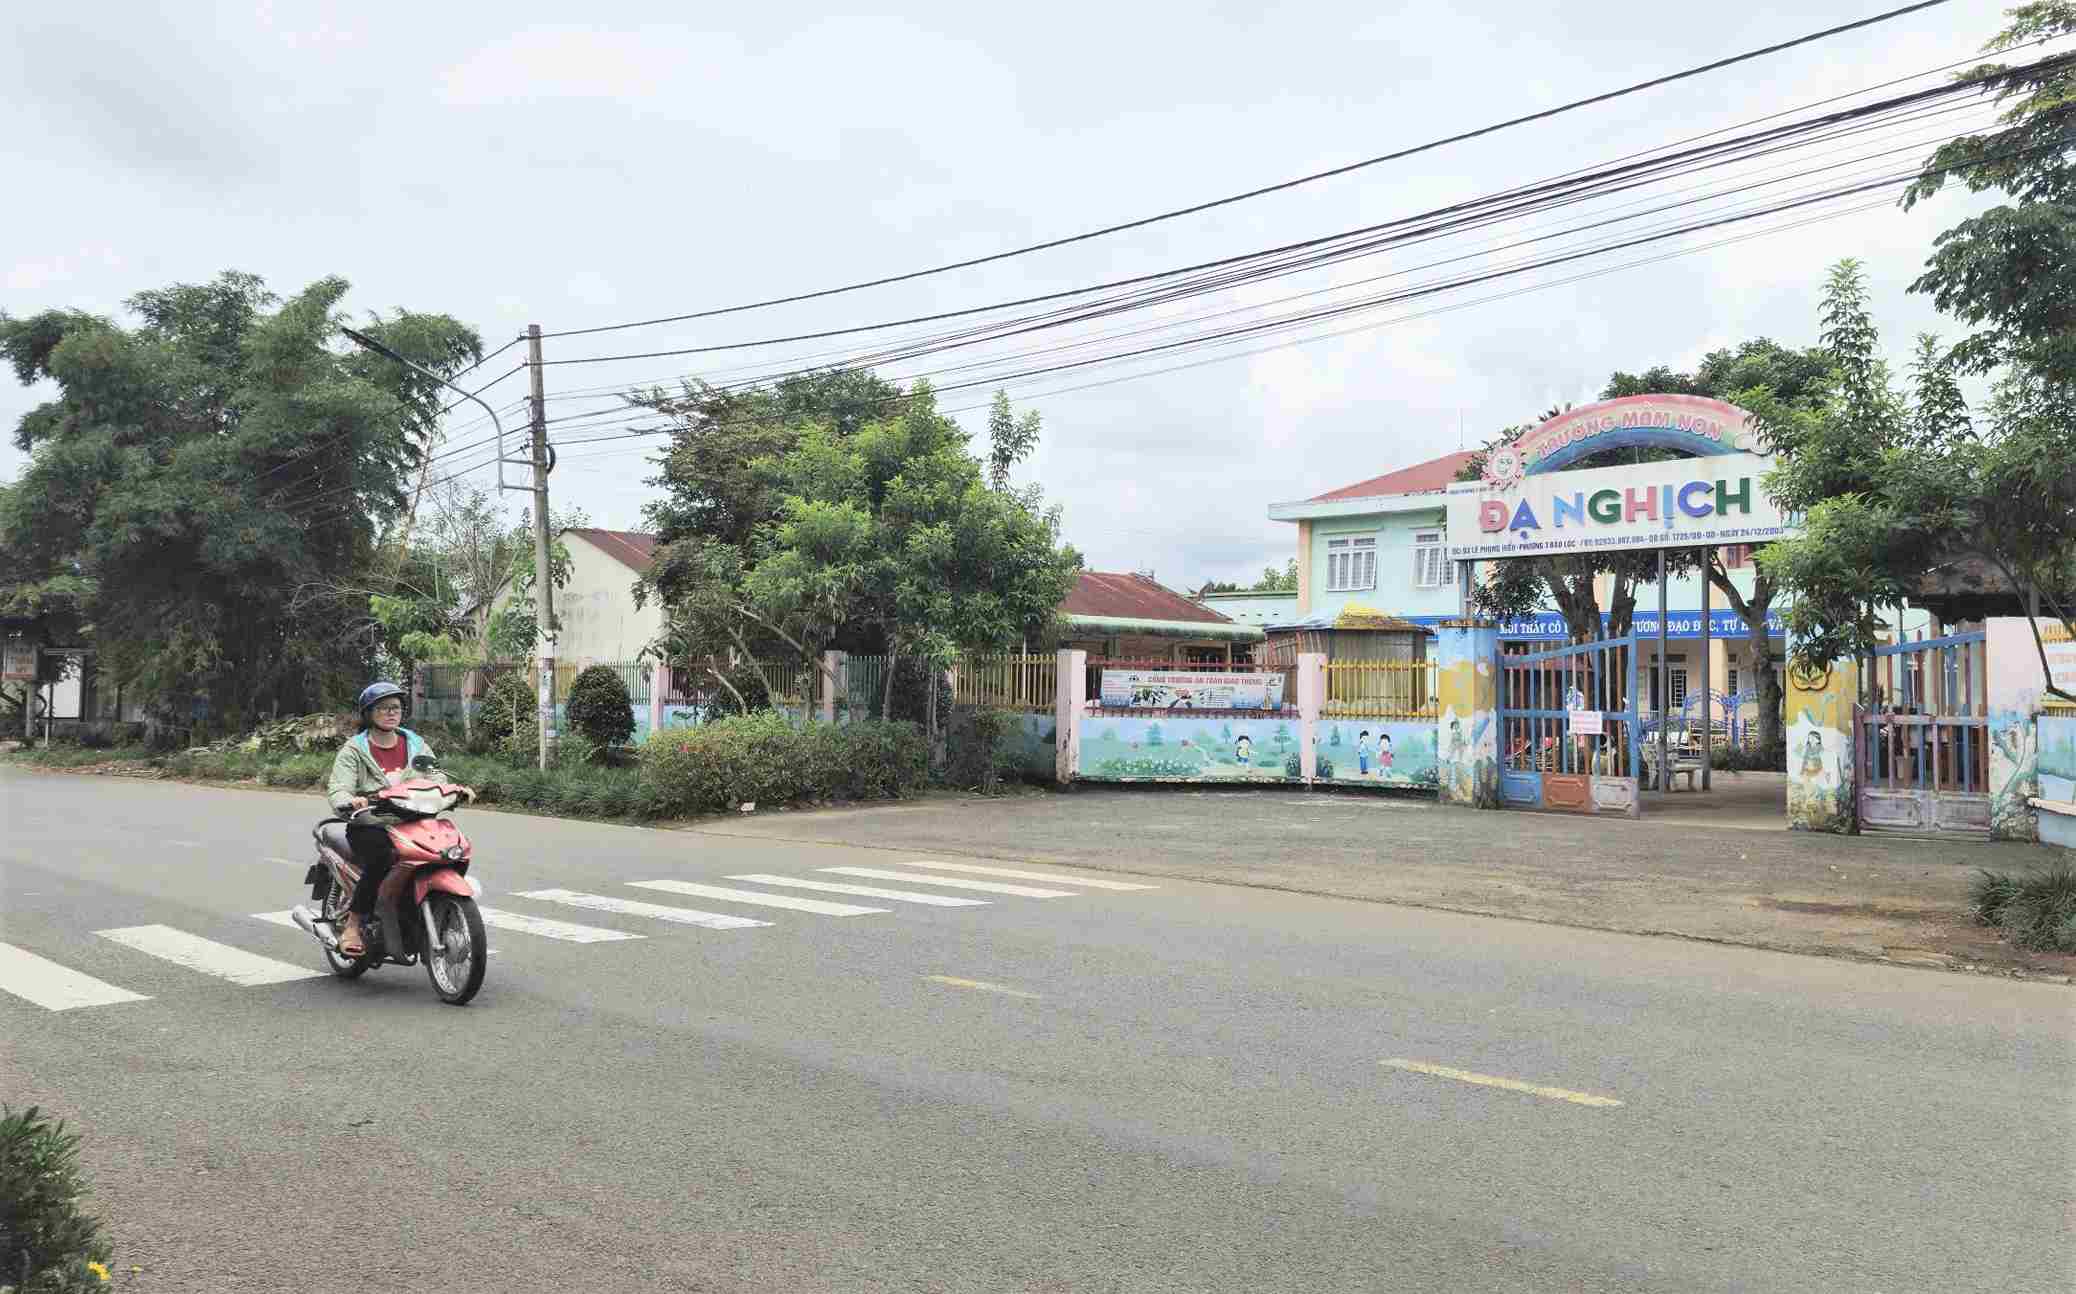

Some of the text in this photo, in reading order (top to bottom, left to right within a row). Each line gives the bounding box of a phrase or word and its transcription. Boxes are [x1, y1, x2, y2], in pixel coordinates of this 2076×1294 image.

[1678, 413, 1722, 441] NON
[1479, 477, 1752, 540] ĐẠ NGHỊCH
[1667, 619, 1690, 635] ĐẠO
[1693, 619, 1719, 634] ĐC,
